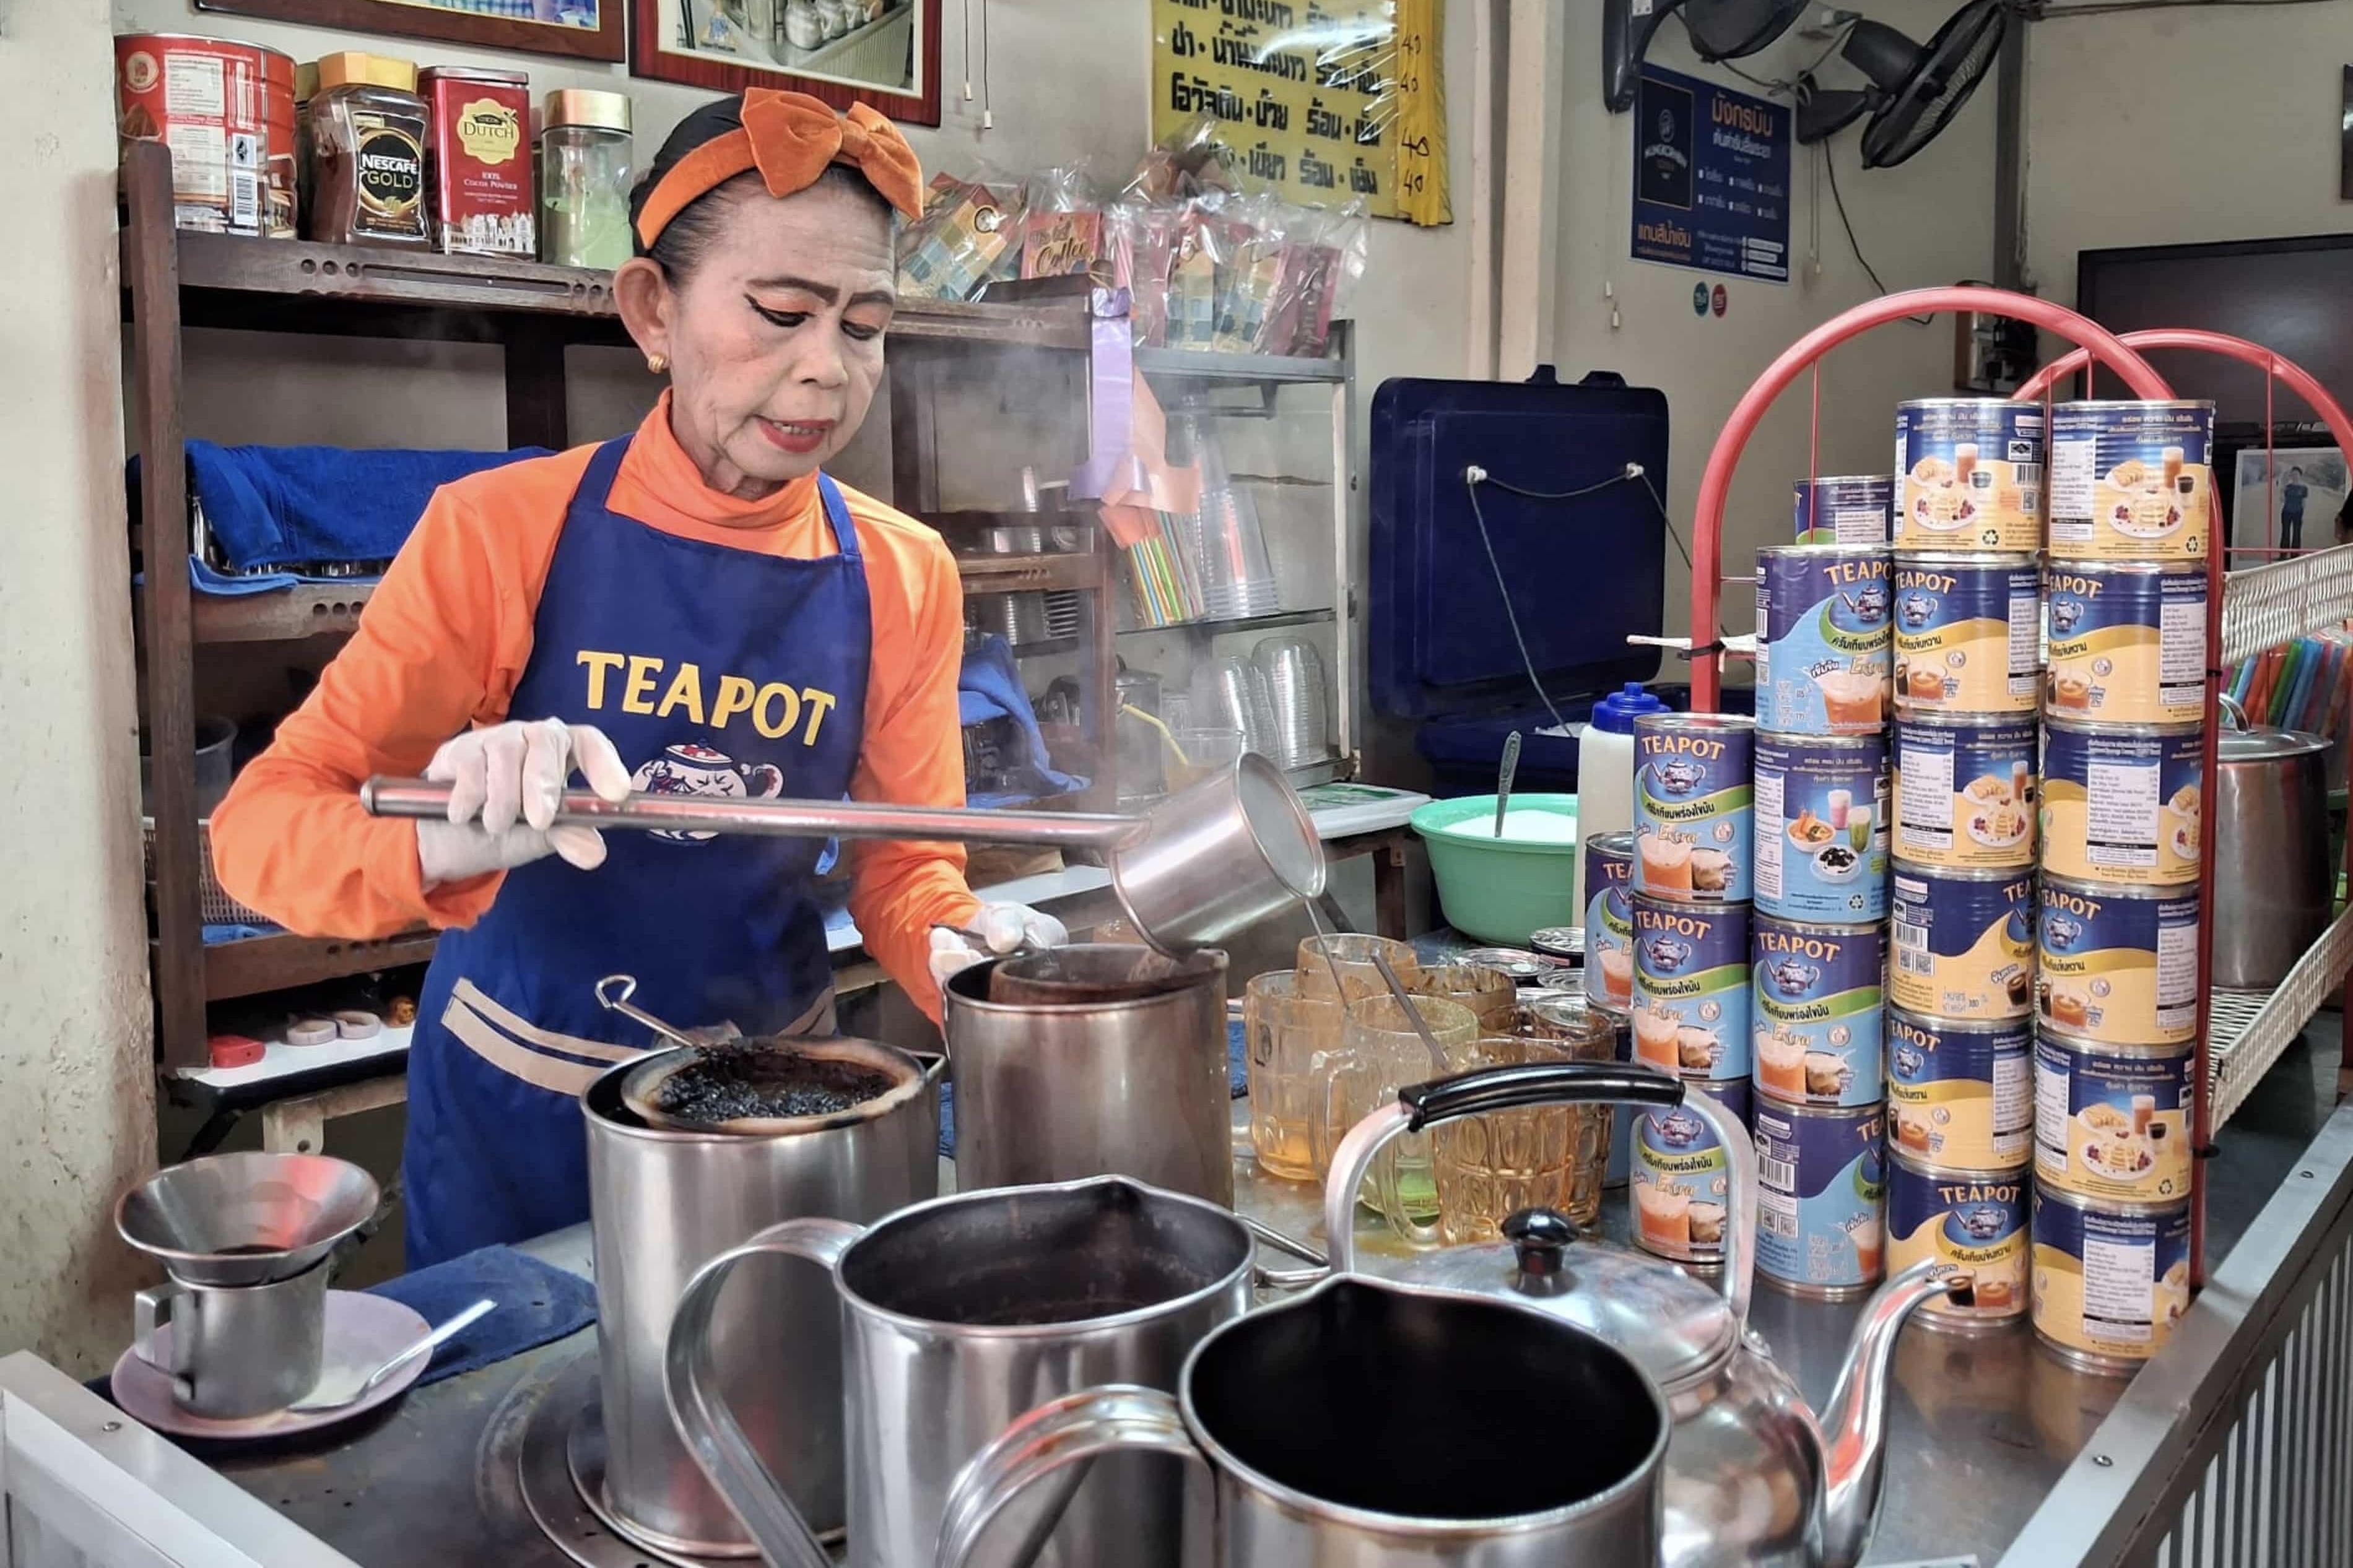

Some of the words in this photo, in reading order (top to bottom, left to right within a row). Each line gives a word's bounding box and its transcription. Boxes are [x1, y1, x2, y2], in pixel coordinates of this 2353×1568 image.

[464, 122, 514, 139] DUTCH
[1306, 97, 1342, 141] ร้อน
[367, 170, 414, 189] GOLD
[1300, 147, 1334, 189] ร้อน
[1824, 560, 1892, 585] TEAPO
[1895, 571, 1957, 594] TEAPOT
[2050, 574, 2103, 599] EAPOT
[576, 650, 837, 746] TEAPOT
[1642, 735, 1725, 761] TEAPOT
[1635, 911, 1711, 940] TEAPOT
[1758, 932, 1841, 963] TEAPOT
[1938, 1185, 2020, 1205] TEAPOT
